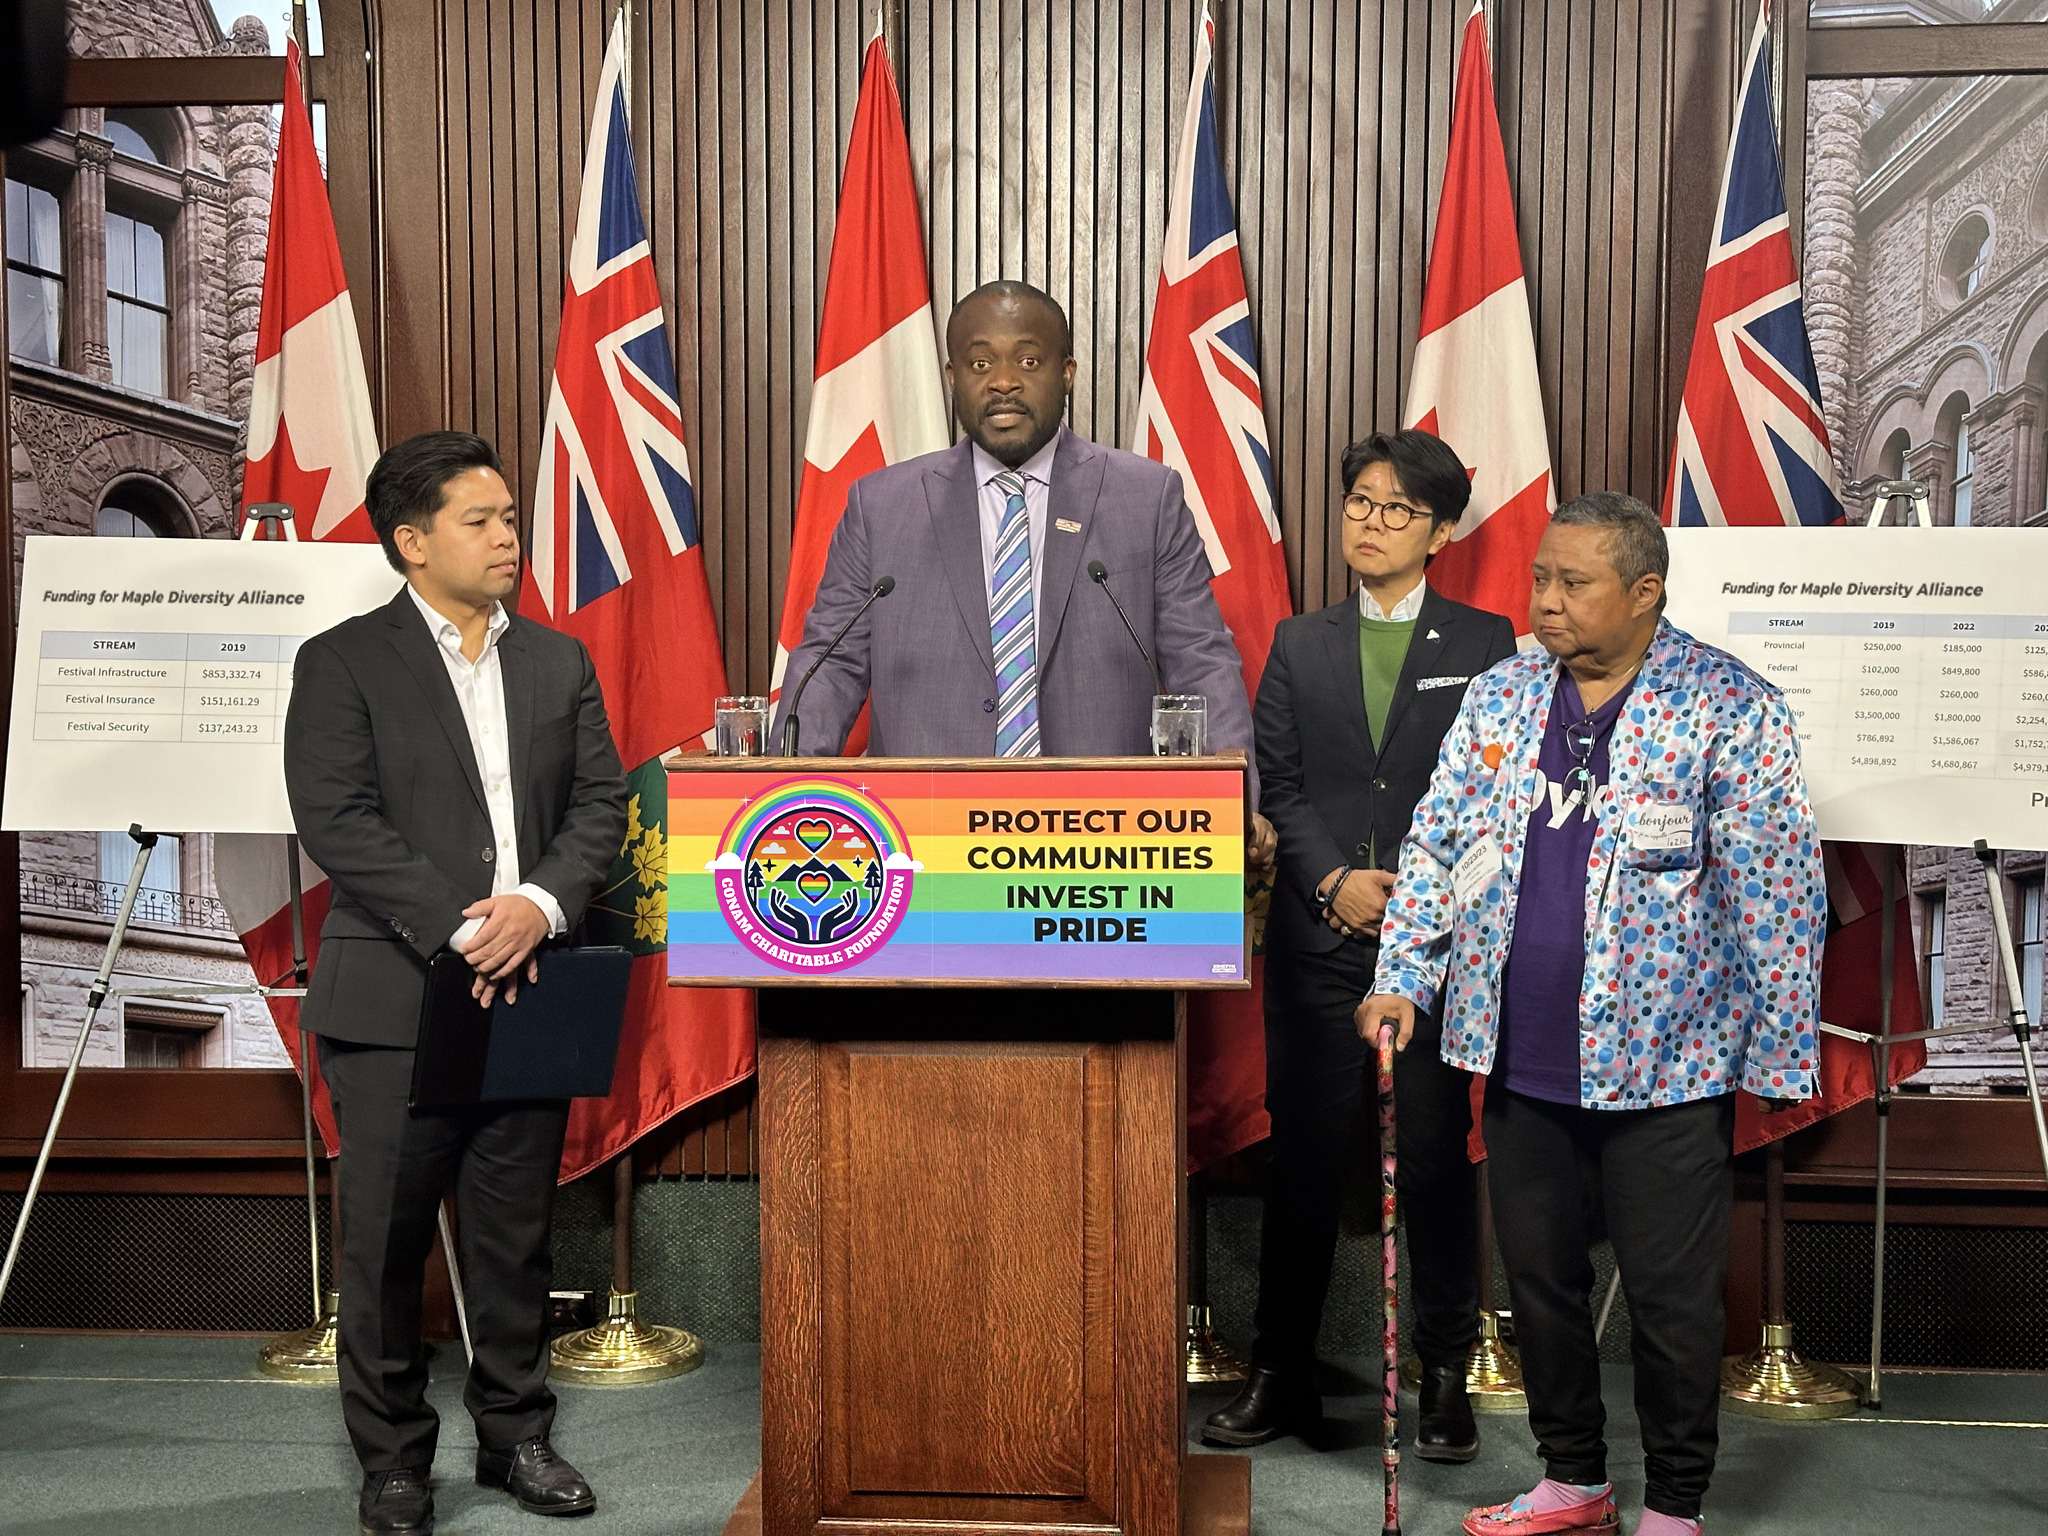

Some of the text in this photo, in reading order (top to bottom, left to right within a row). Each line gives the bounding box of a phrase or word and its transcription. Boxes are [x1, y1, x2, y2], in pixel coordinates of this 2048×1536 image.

[1721, 581, 1984, 599] Funding for Maple Diversity Alliance
[42, 589, 305, 607] Funding for Maple Diversity Alliance
[1768, 619, 1804, 627] STREAM
[1872, 621, 1895, 630] 2019
[1952, 622, 1975, 631] 2022
[92, 640, 246, 652] STREAM 2019
[1763, 641, 1805, 650] Provincial
[1863, 642, 1902, 652] $250,000
[1942, 643, 1983, 654] $185,000
[58, 666, 261, 680] Festival Infrastructure $853,332.74
[1767, 663, 1798, 672] Federal
[1861, 665, 1900, 675] $102,000
[1941, 666, 1981, 677] $849,800
[65, 694, 260, 707] Festival Insurance $151,161.29
[1860, 687, 1899, 697] $260,000
[1939, 689, 1979, 700] $260,000
[1854, 710, 1901, 721] $3,500,000
[1934, 712, 1982, 723] $1,800,000
[67, 721, 258, 735] Festival Security $137,243.23
[1856, 733, 1895, 743] $786,892
[1932, 735, 1980, 746] $1,586,067
[1851, 756, 1897, 767] $4,898,892
[1931, 759, 1978, 770] $4,680,867
[968, 809, 1212, 834] PROTECT OUR
[1637, 812, 1692, 832] bonjour
[967, 846, 1214, 870] COMMUNITIES
[1461, 845, 1487, 871] 10/23/23
[1007, 885, 1174, 909] INVEST IN
[721, 874, 905, 967] CONAM CHARITABLE FOUNDATION
[1034, 917, 1148, 943] PRIDE
